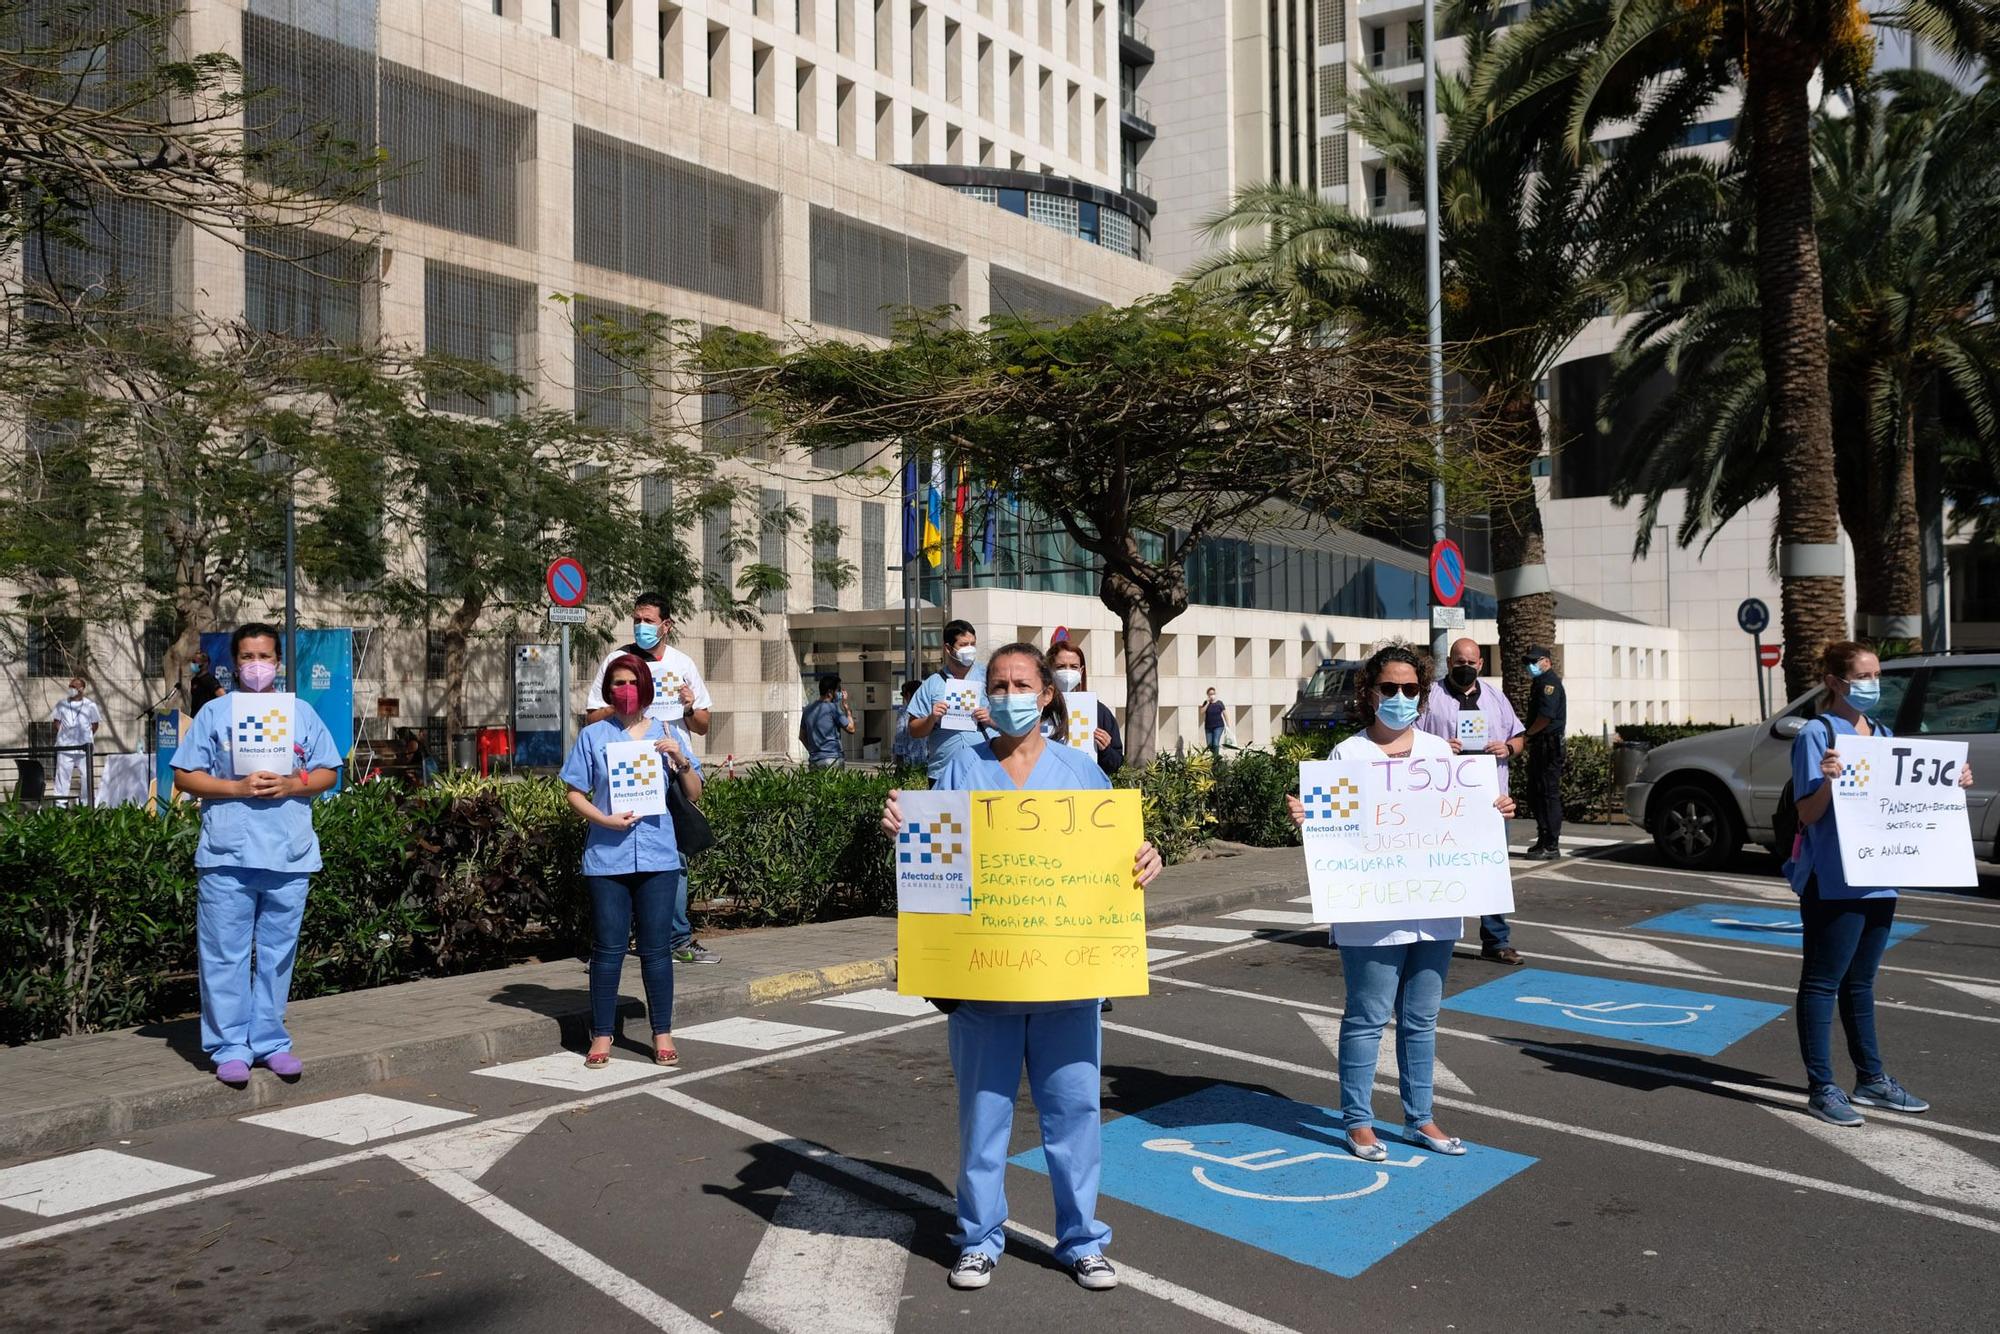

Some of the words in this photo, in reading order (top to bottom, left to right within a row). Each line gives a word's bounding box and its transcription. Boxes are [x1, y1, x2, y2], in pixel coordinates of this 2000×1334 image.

[1376, 803, 1406, 826] ES
[1440, 797, 1466, 818] DE
[1363, 830, 1457, 851] JUSTICIA
[1858, 847, 1874, 859] OPE
[1881, 843, 1920, 857] ANULADA
[980, 853, 1062, 870] ESFUERZO
[1315, 855, 1407, 873] CONSIDERAR
[1428, 850, 1506, 868] NUESTRO
[901, 872, 943, 881] Afectadxs
[945, 872, 963, 881] OPE
[980, 872, 1055, 887] SACRIFICIO
[1061, 872, 1121, 888] FAMILIAR
[1327, 878, 1467, 909] ESFUERZO
[981, 913, 1049, 928] PRIORIZAR
[1055, 914, 1093, 927] SALUD
[968, 949, 1048, 972] ANULAR
[1065, 946, 1101, 967] OPE
